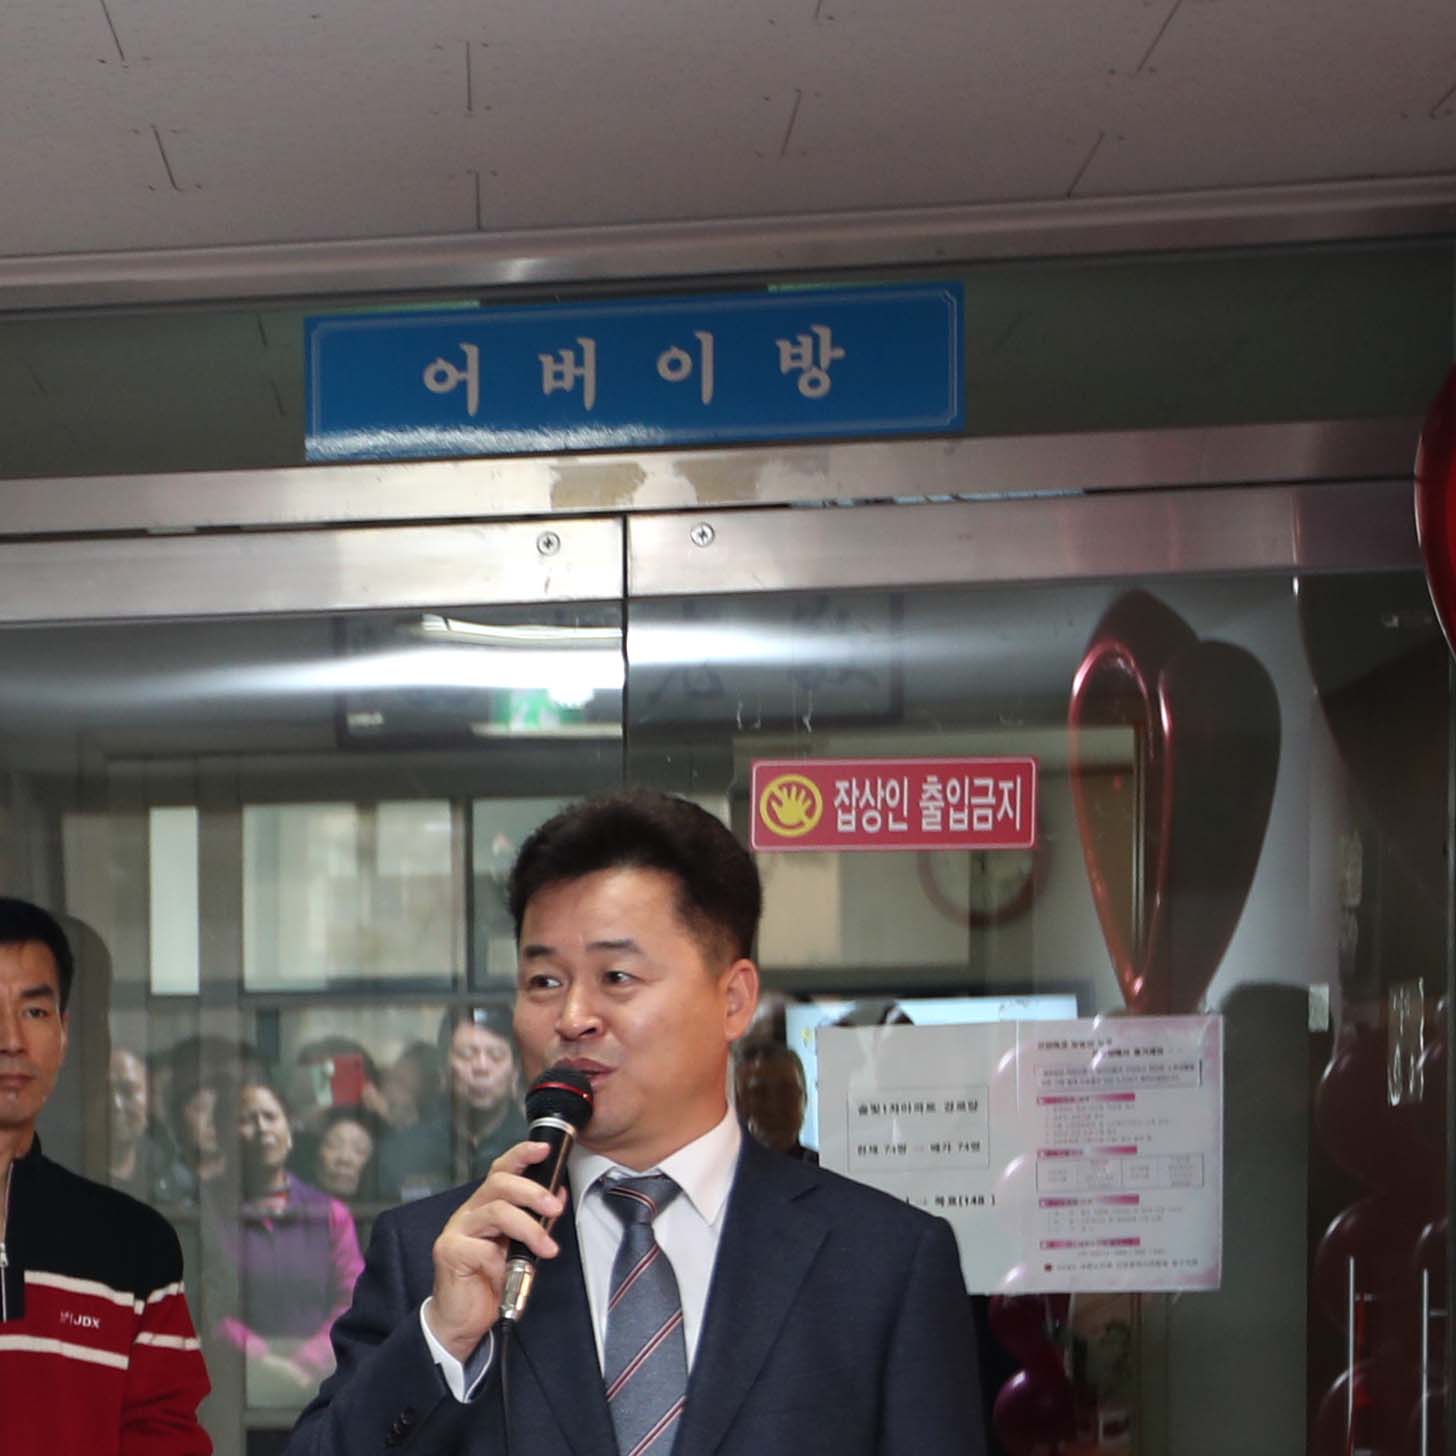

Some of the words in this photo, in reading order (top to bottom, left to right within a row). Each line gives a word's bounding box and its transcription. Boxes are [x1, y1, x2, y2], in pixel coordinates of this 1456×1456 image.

[422, 324, 845, 417] 어버이방
[833, 775, 909, 834] 잡상인
[919, 774, 1022, 832] 출입금지
